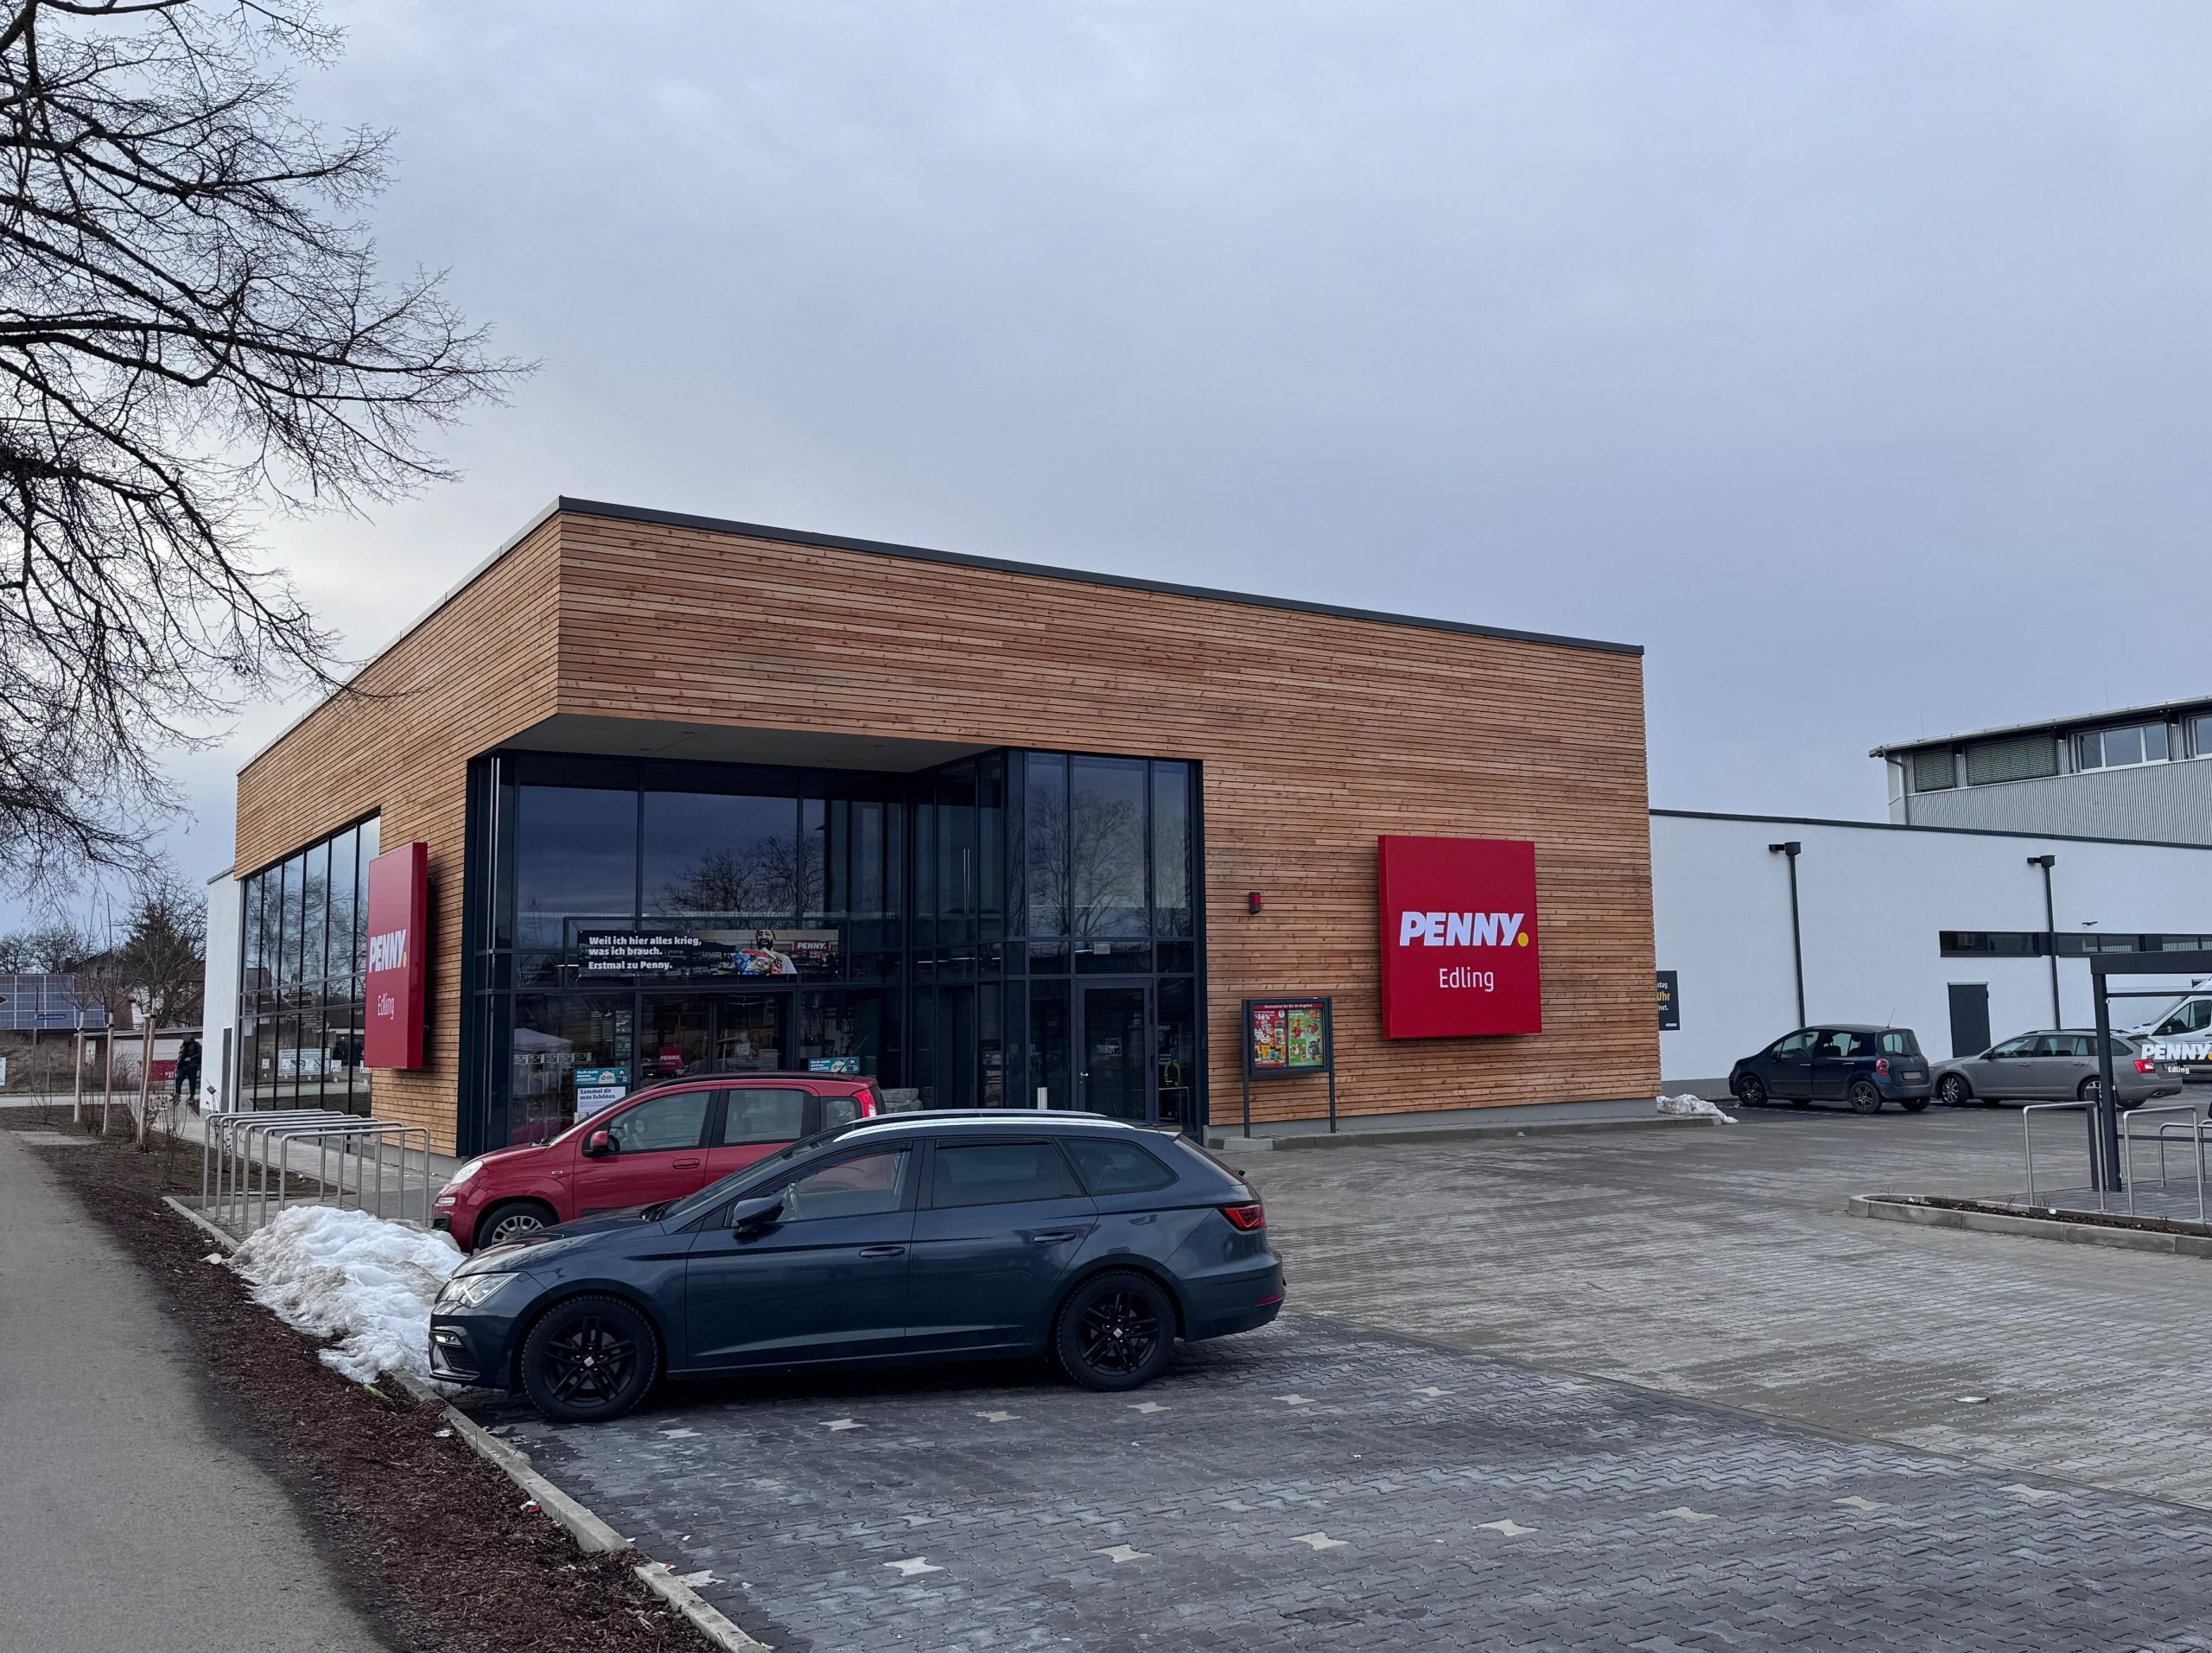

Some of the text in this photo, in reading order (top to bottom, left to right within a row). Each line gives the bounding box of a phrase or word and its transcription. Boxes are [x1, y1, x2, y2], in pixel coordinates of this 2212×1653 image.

[1400, 912, 1529, 947] PENNY.
[588, 936, 702, 946] Weil ich hier alles krieg,
[611, 946, 626, 956] ich
[627, 946, 663, 956] brauch.
[588, 961, 626, 970] Erstmal
[640, 961, 673, 970] Penny.
[1439, 966, 1494, 992] Edling
[378, 993, 395, 1020] Edling
[2167, 1065, 2190, 1075] Edling
